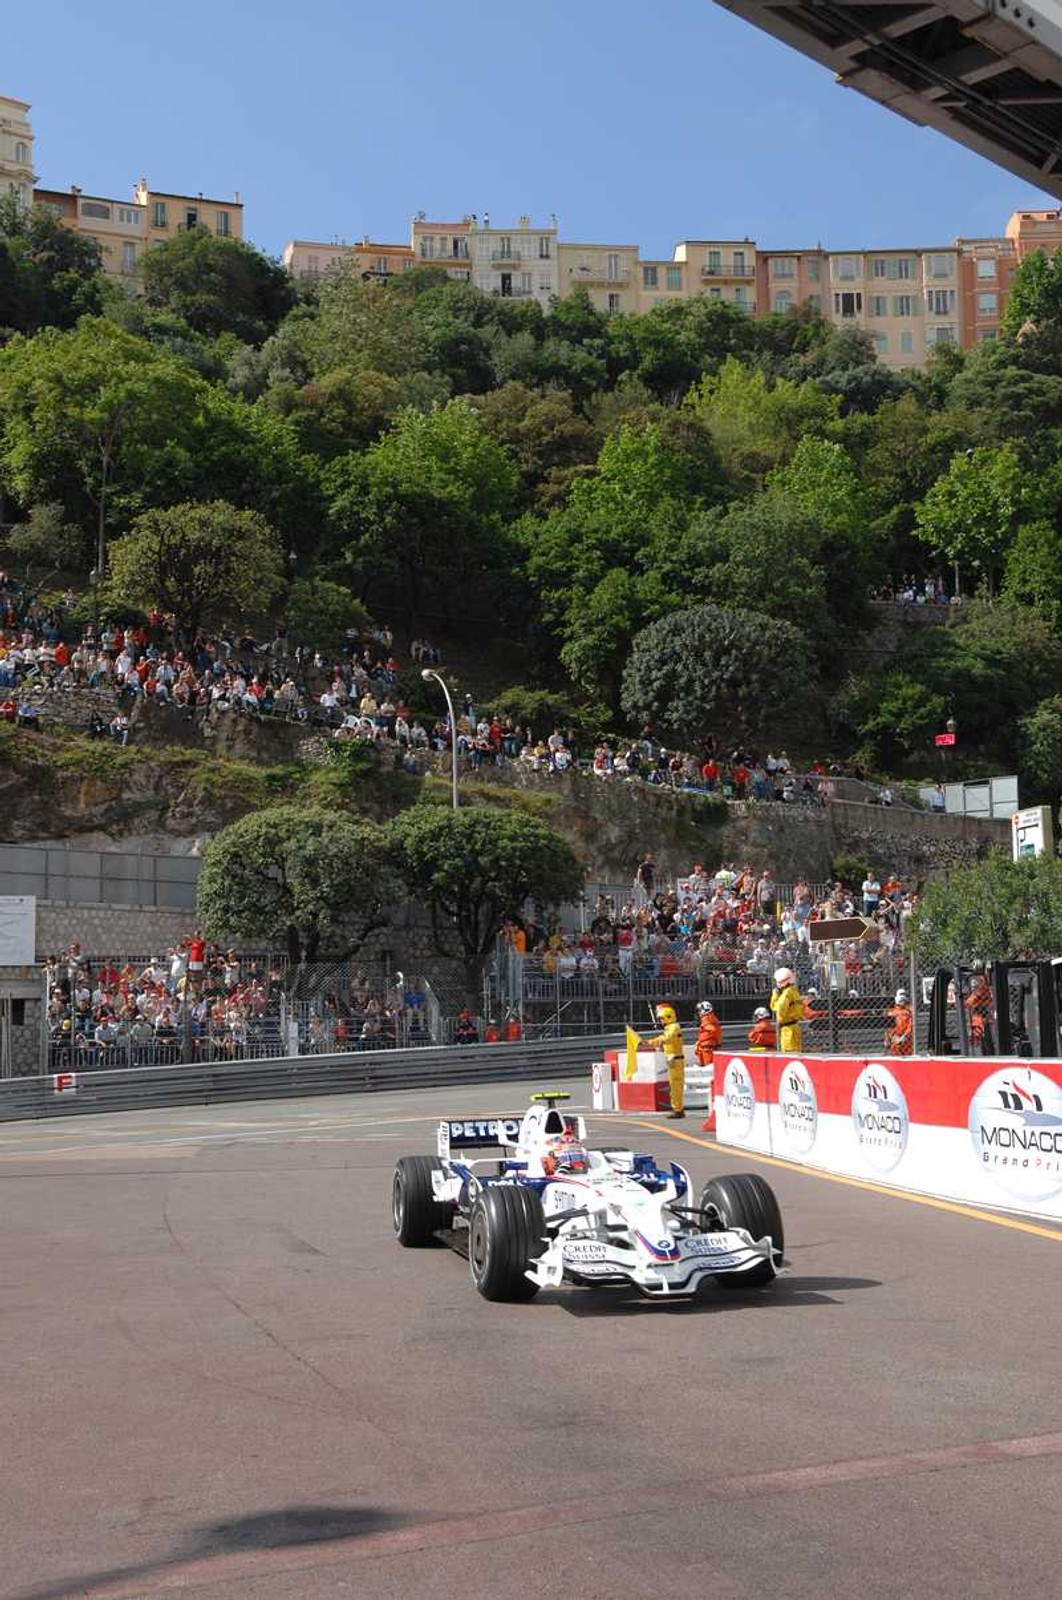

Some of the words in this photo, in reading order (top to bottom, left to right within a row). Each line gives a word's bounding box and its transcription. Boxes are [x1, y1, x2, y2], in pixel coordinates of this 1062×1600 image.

[783, 1102, 814, 1122] MONACO
[450, 1120, 522, 1137] PETRO
[857, 1113, 902, 1134] MONACO
[982, 1151, 1030, 1168] Grand
[1035, 1158, 1062, 1172] Pri
